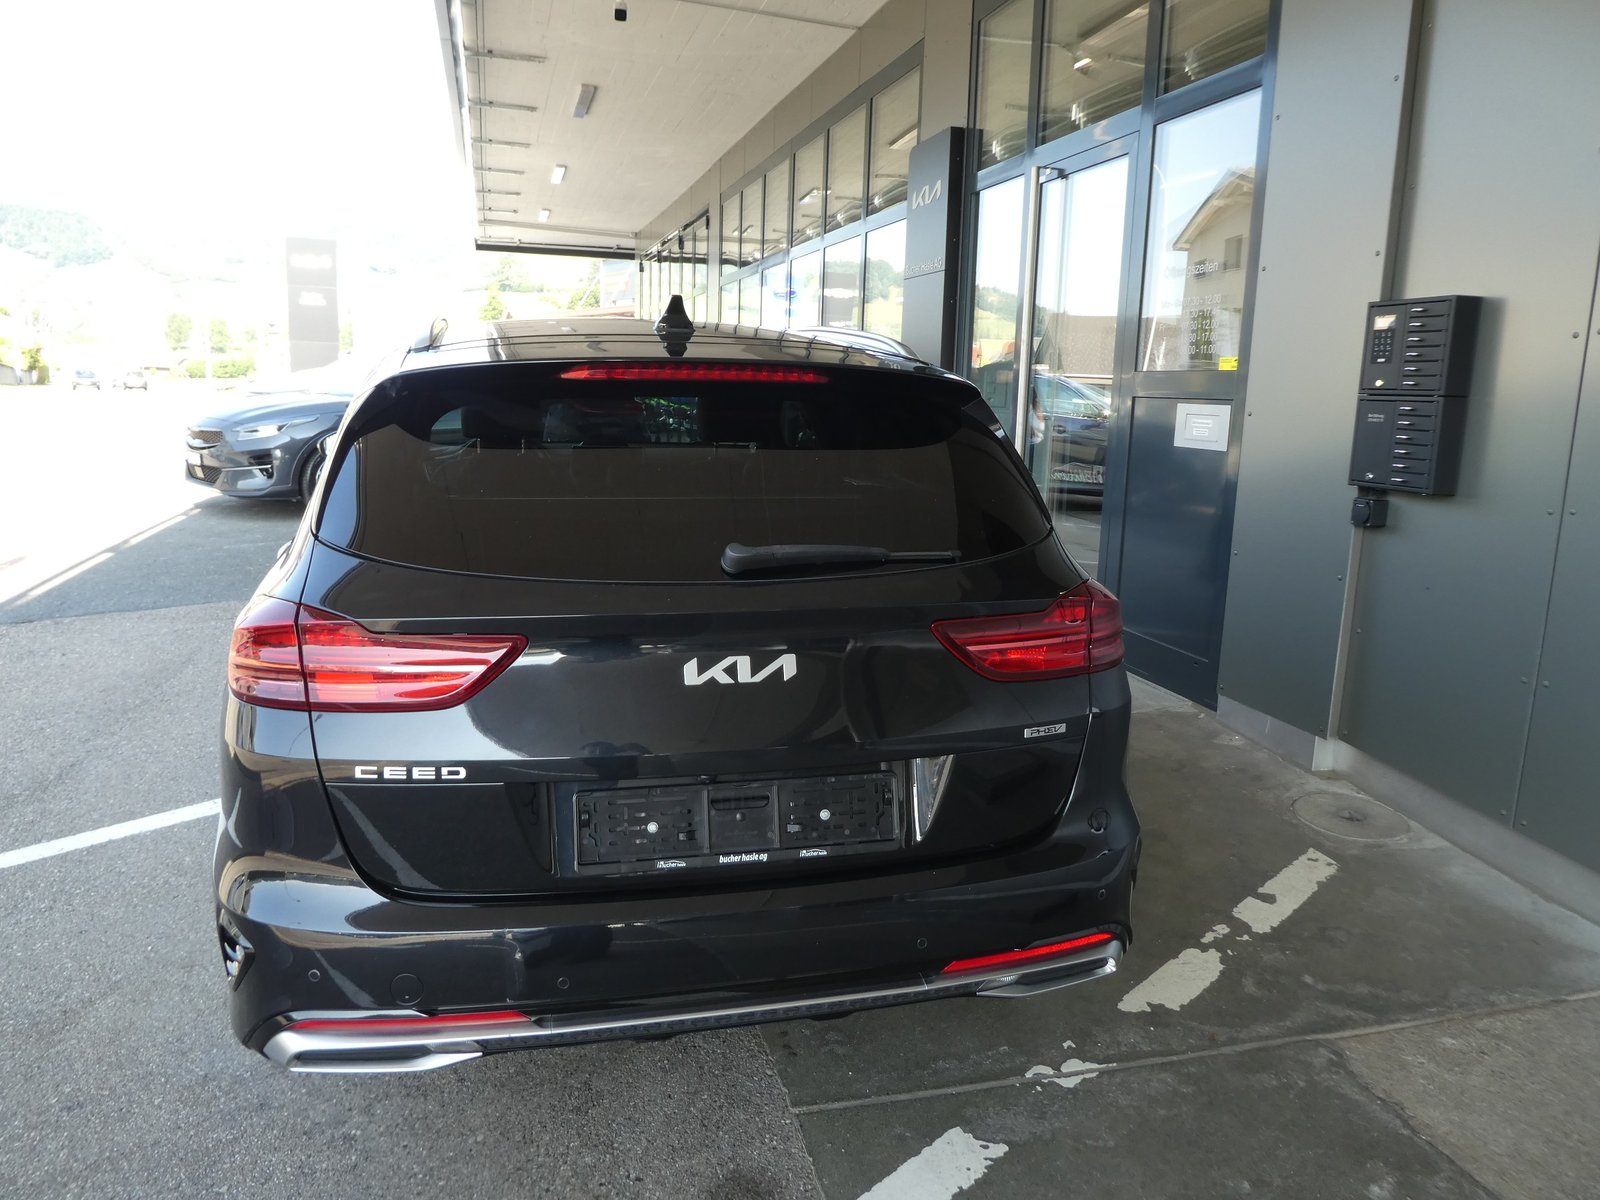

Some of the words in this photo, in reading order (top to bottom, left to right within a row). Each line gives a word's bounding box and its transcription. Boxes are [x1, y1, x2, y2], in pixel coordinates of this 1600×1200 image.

[911, 179, 942, 210] KIA
[1202, 319, 1219, 330] 12.00
[1200, 344, 1217, 354] 11.00
[684, 653, 797, 685] KIA
[1029, 724, 1064, 736] PHEV
[354, 765, 467, 779] CEED
[719, 854, 742, 864] bucher
[741, 853, 757, 863] hasle
[758, 852, 768, 863] ag
